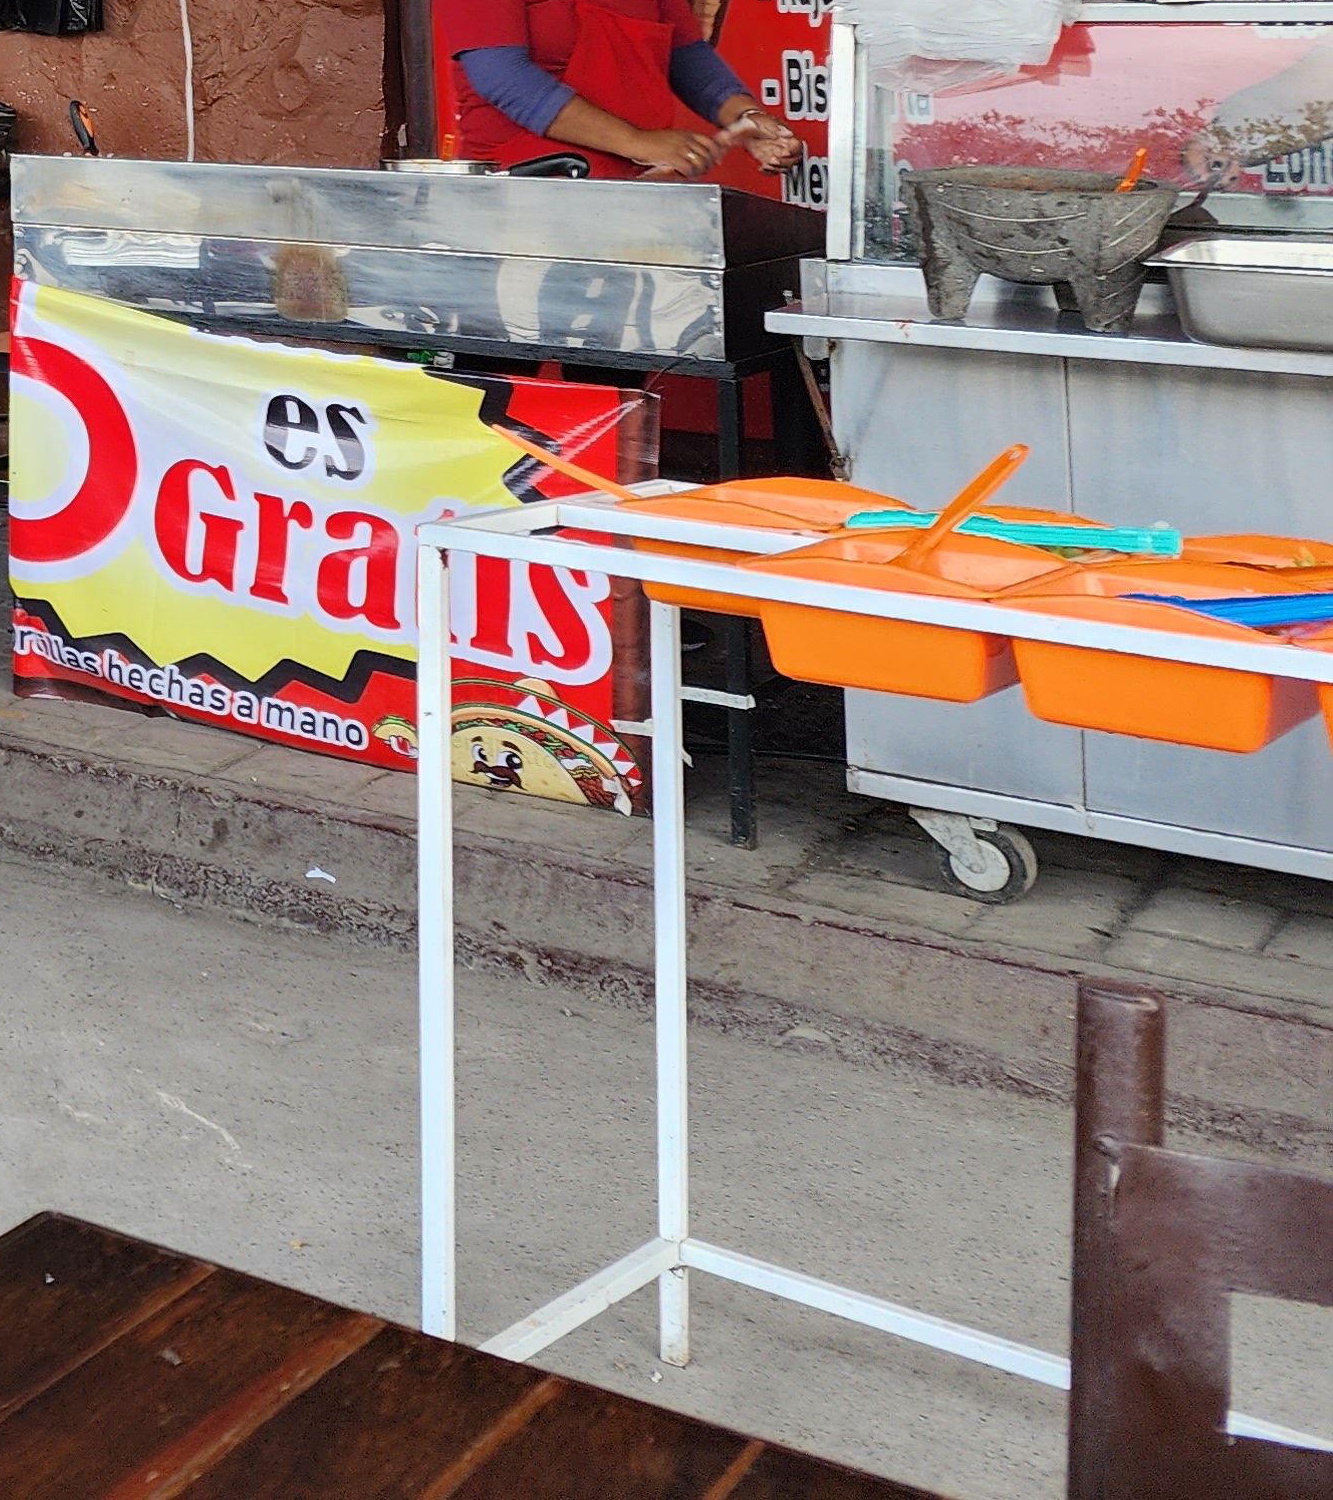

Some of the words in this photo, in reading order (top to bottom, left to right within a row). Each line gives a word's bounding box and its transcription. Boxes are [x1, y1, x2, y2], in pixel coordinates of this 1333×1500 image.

[264, 393, 367, 480] es
[154, 457, 592, 669] Grais
[108, 653, 228, 712] hechas
[236, 695, 255, 721] a
[266, 706, 364, 747] mano
